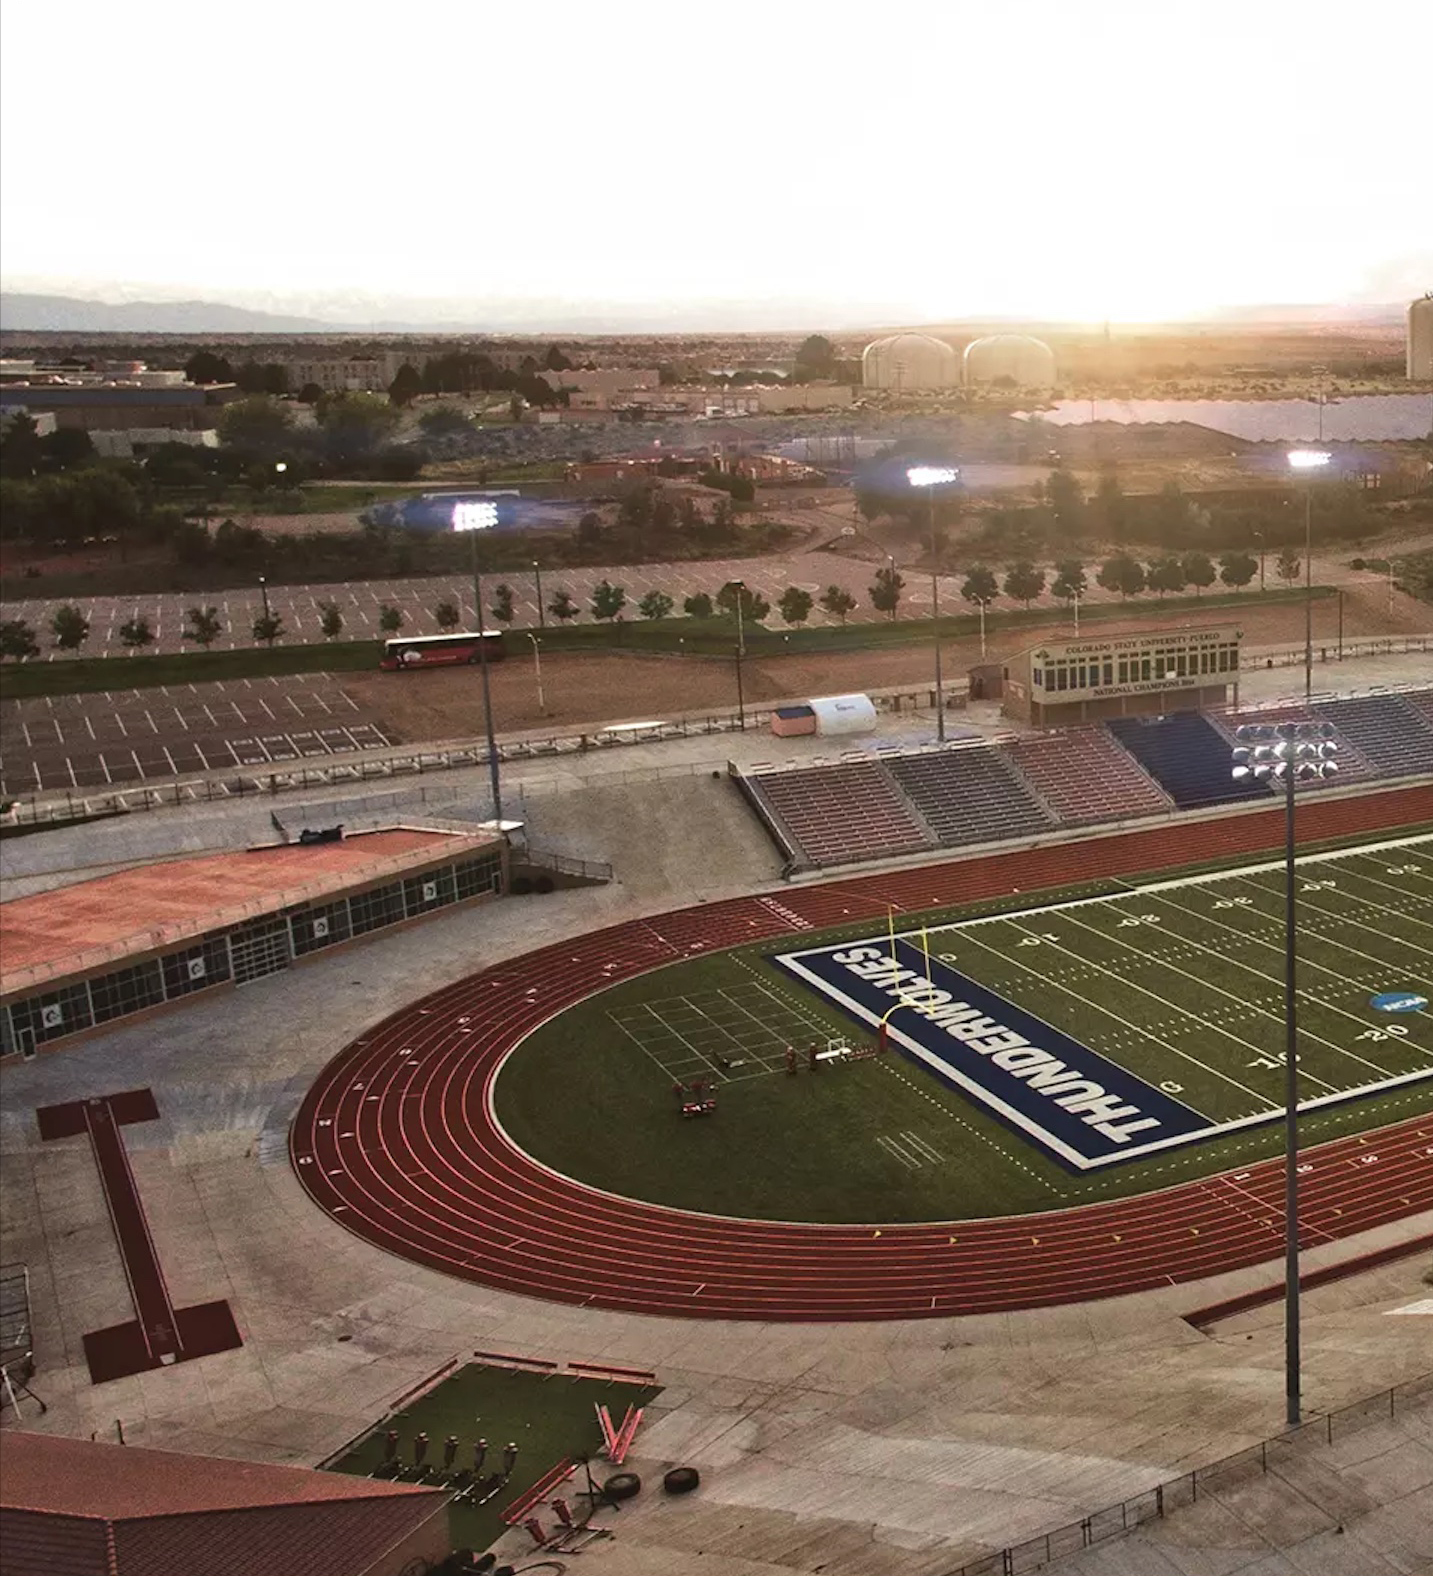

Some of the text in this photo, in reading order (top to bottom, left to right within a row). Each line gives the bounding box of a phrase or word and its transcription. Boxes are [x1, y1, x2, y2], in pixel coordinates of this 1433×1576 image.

[1066, 643, 1111, 654] COLORADO
[1093, 687, 1132, 697] NATIONAL
[1134, 680, 1180, 693] CHAMPIONS
[1364, 1024, 1409, 1042] 20
[831, 946, 1162, 1145] THUNDERWOLVES
